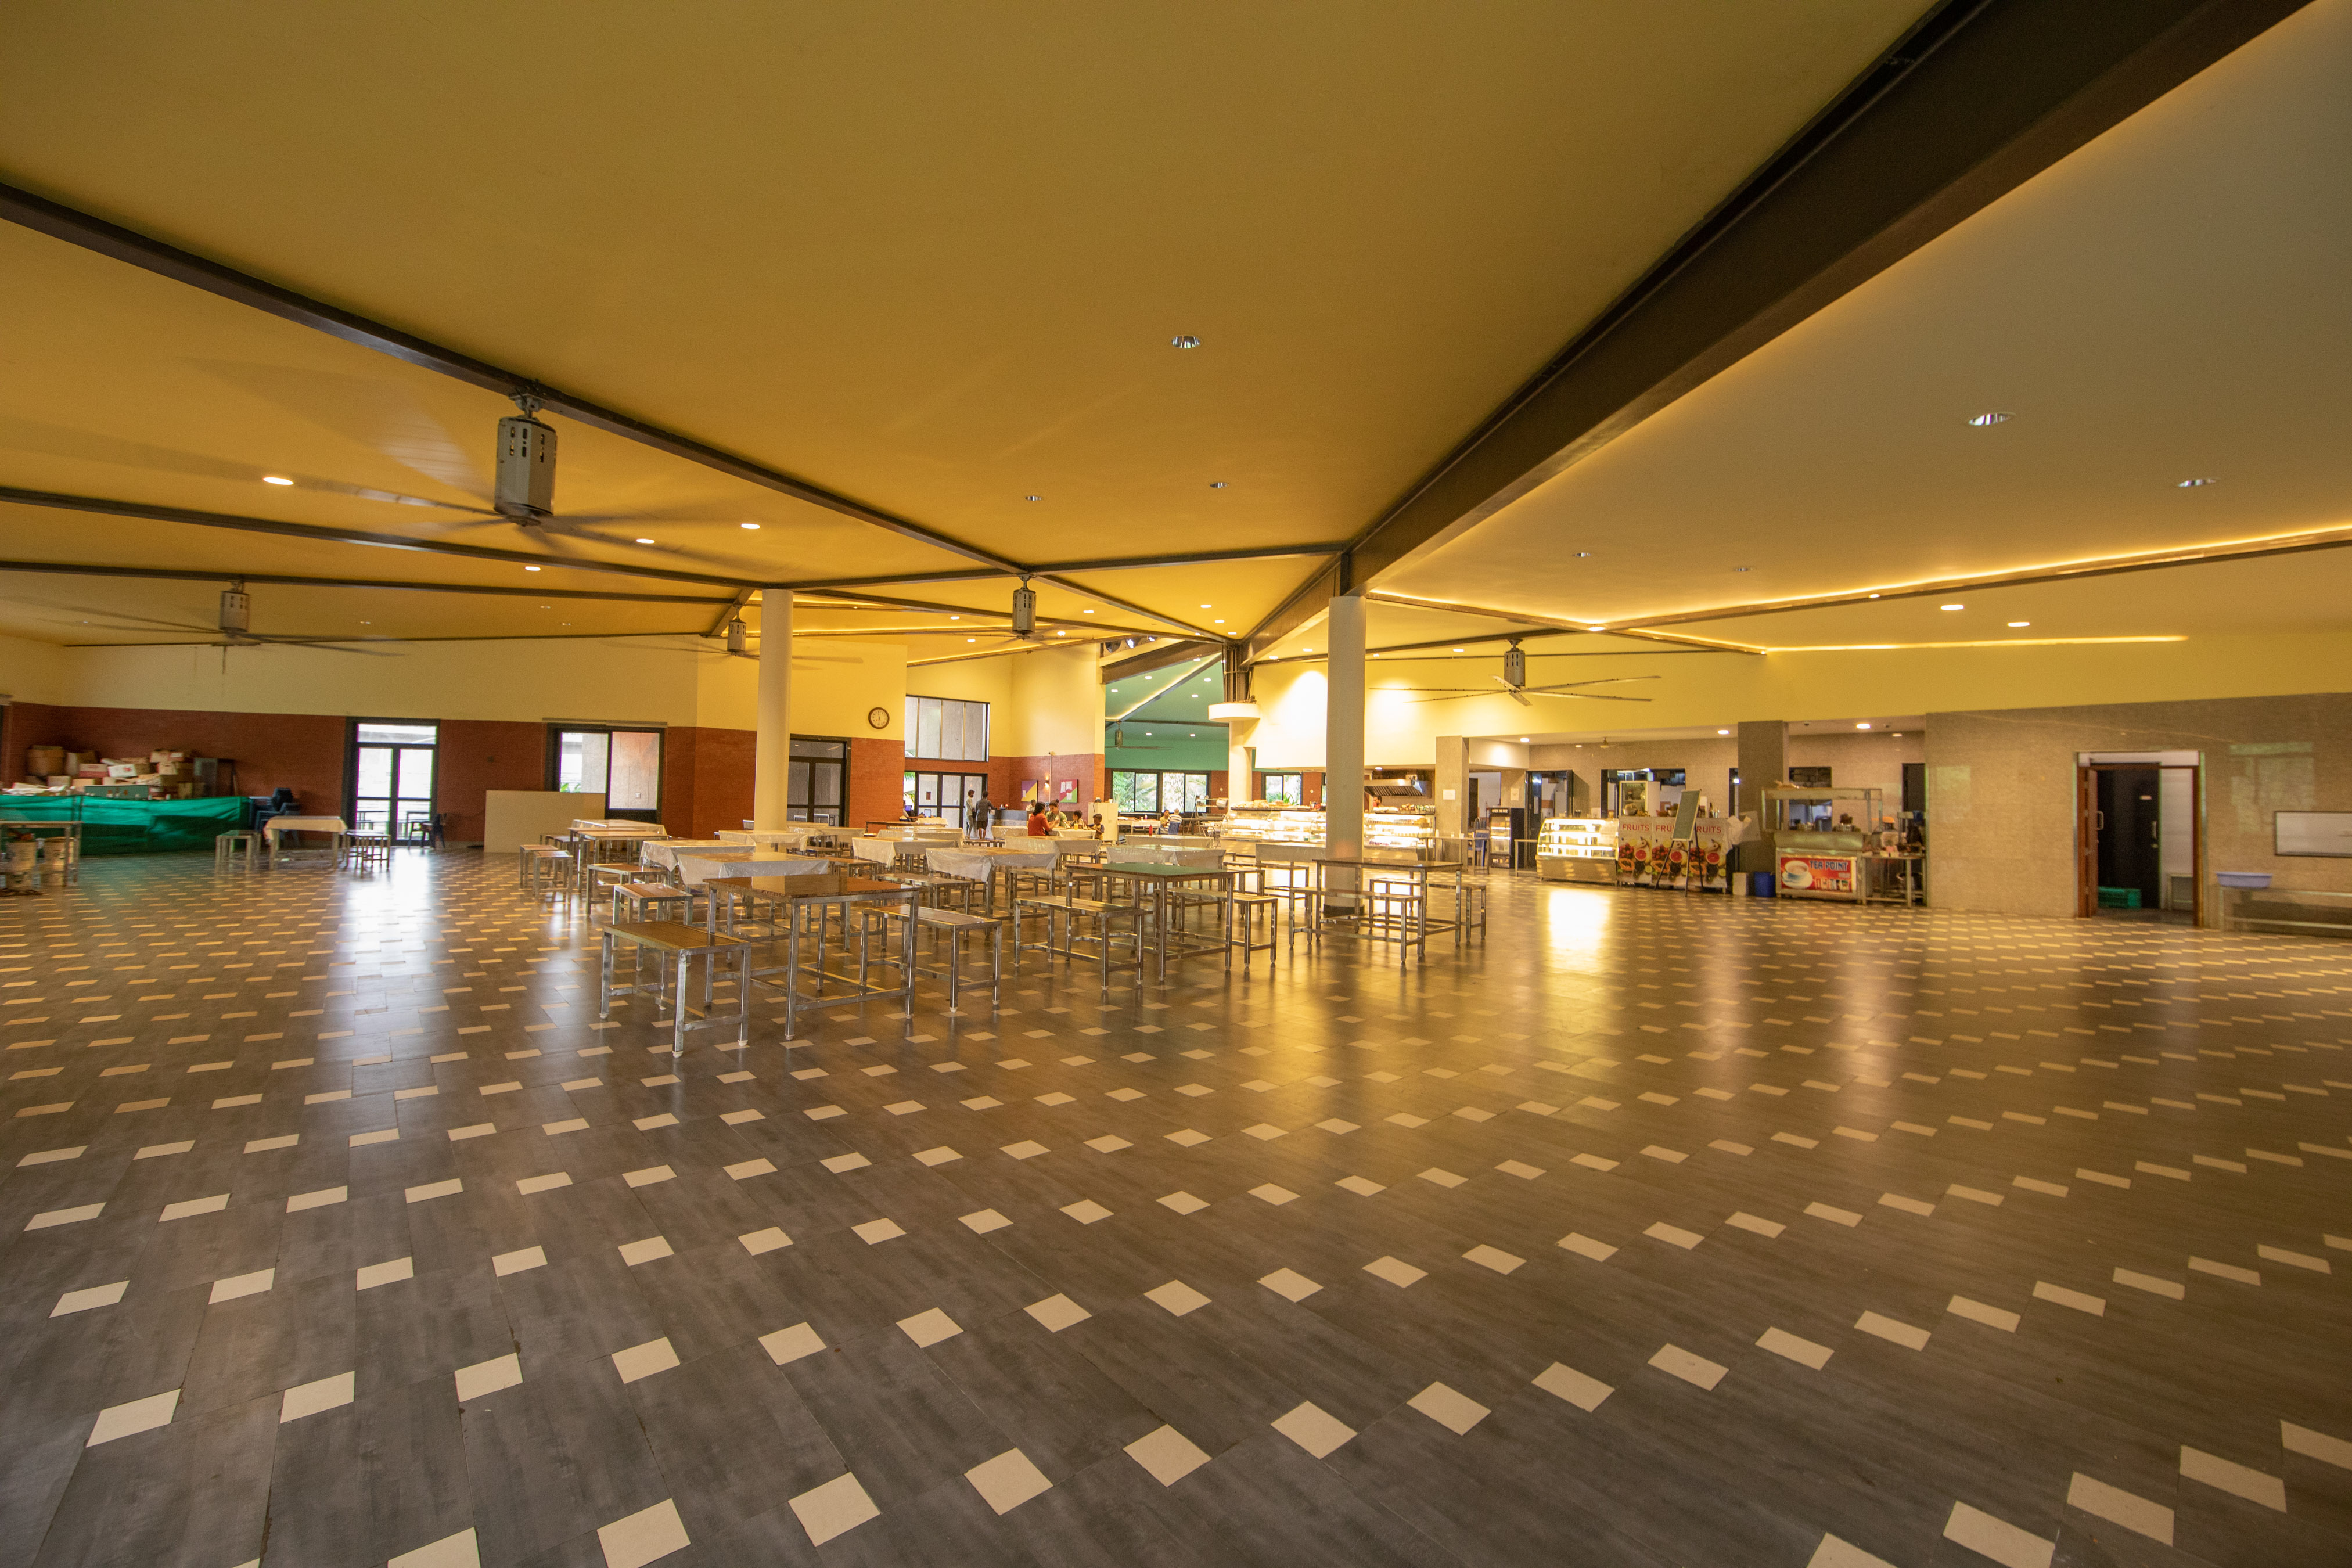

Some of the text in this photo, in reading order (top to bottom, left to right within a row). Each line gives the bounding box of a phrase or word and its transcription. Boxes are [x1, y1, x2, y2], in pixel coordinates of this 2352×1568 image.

[1696, 825, 1722, 833] RUITS
[1810, 860, 1848, 871] TEA POINT
